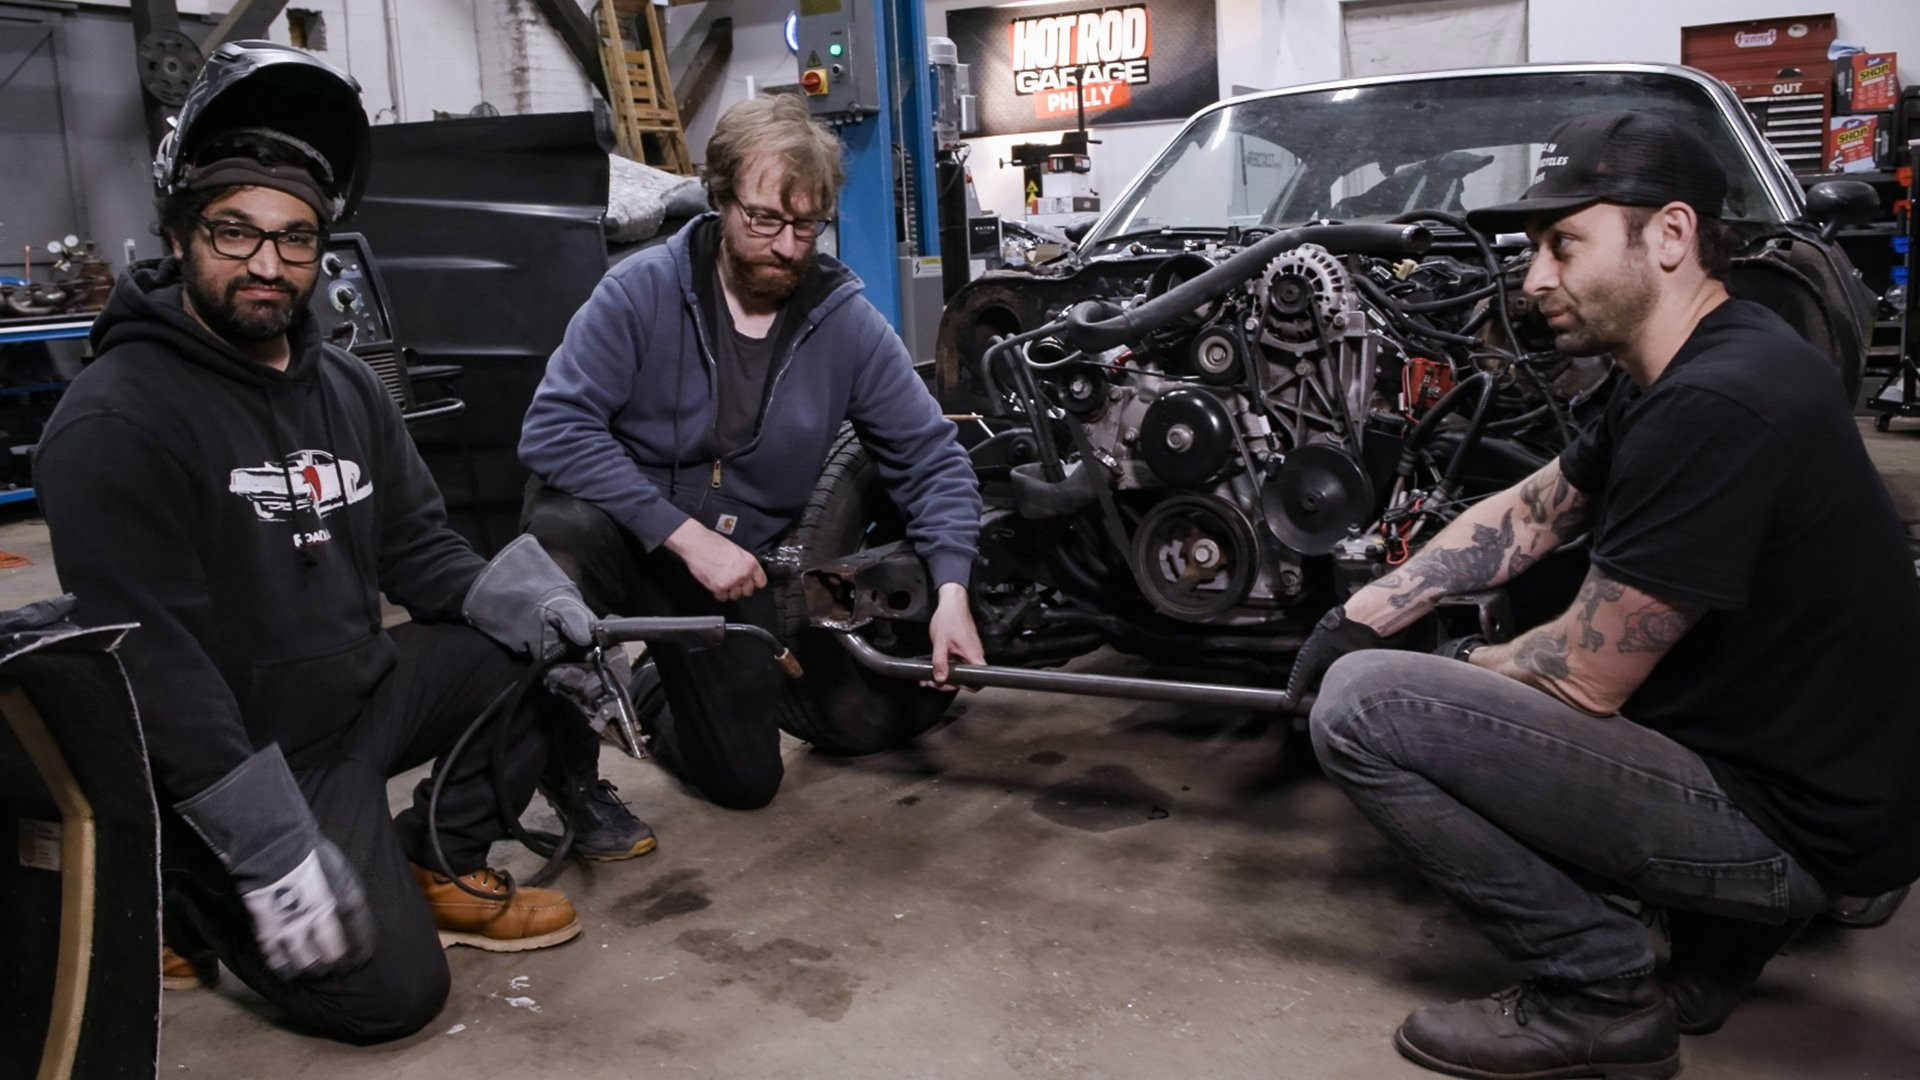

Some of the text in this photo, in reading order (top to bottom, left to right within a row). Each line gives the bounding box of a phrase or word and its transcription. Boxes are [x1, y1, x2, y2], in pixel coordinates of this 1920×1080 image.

[1013, 8, 1147, 71] HOT ROD
[1016, 60, 1147, 93] GARAGE
[1860, 64, 1889, 79] SHOP
[1048, 85, 1115, 112] PHILLY
[1772, 82, 1802, 94] OUT
[1838, 127, 1868, 142] SHOP
